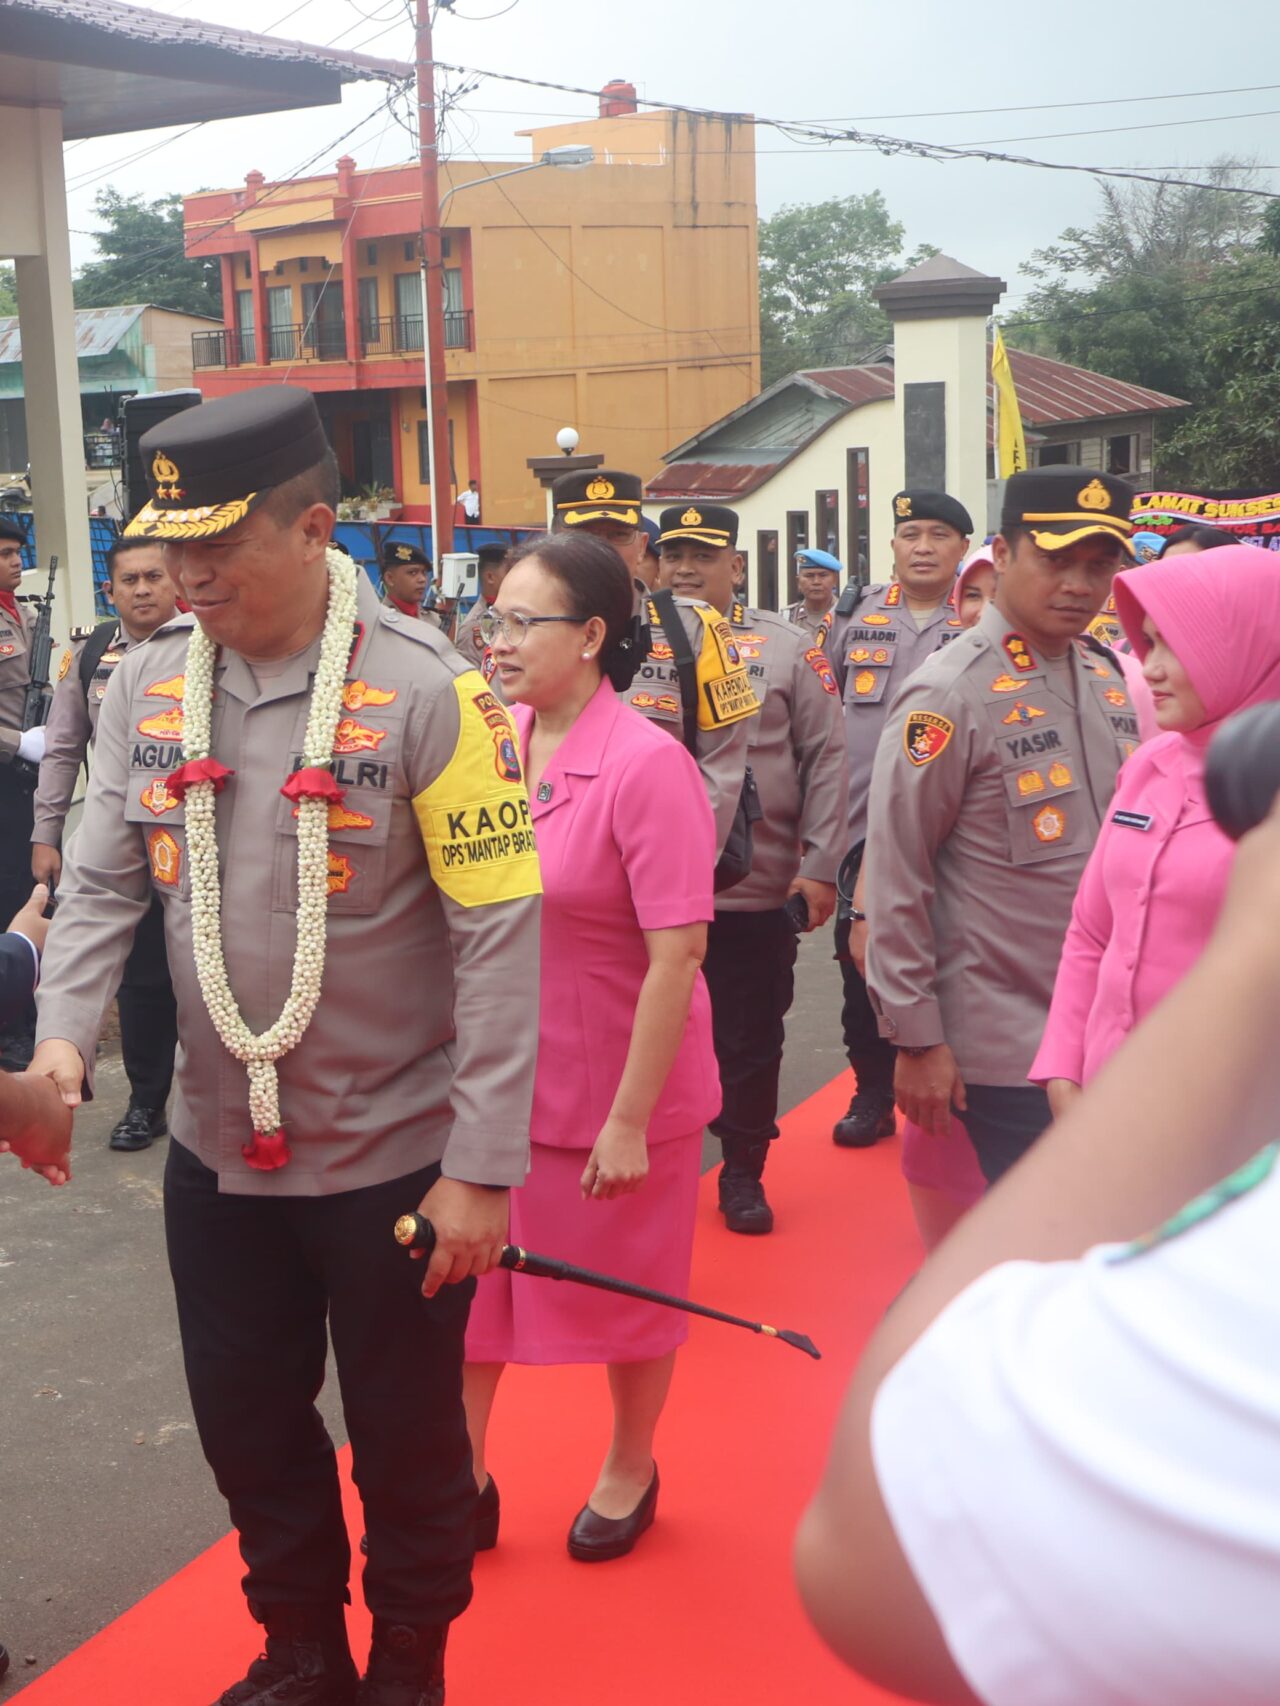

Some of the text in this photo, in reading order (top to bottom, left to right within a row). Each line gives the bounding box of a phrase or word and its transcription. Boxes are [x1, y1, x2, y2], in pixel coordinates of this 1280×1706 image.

[1130, 495, 1204, 514] LAMAT
[851, 630, 896, 642] JALADRI
[641, 666, 678, 682] OLR
[131, 744, 186, 769] AGUN
[1006, 729, 1062, 759] YASIR
[447, 798, 531, 840] KAOP
[441, 843, 465, 868] OPS
[511, 829, 536, 855] BRAT
